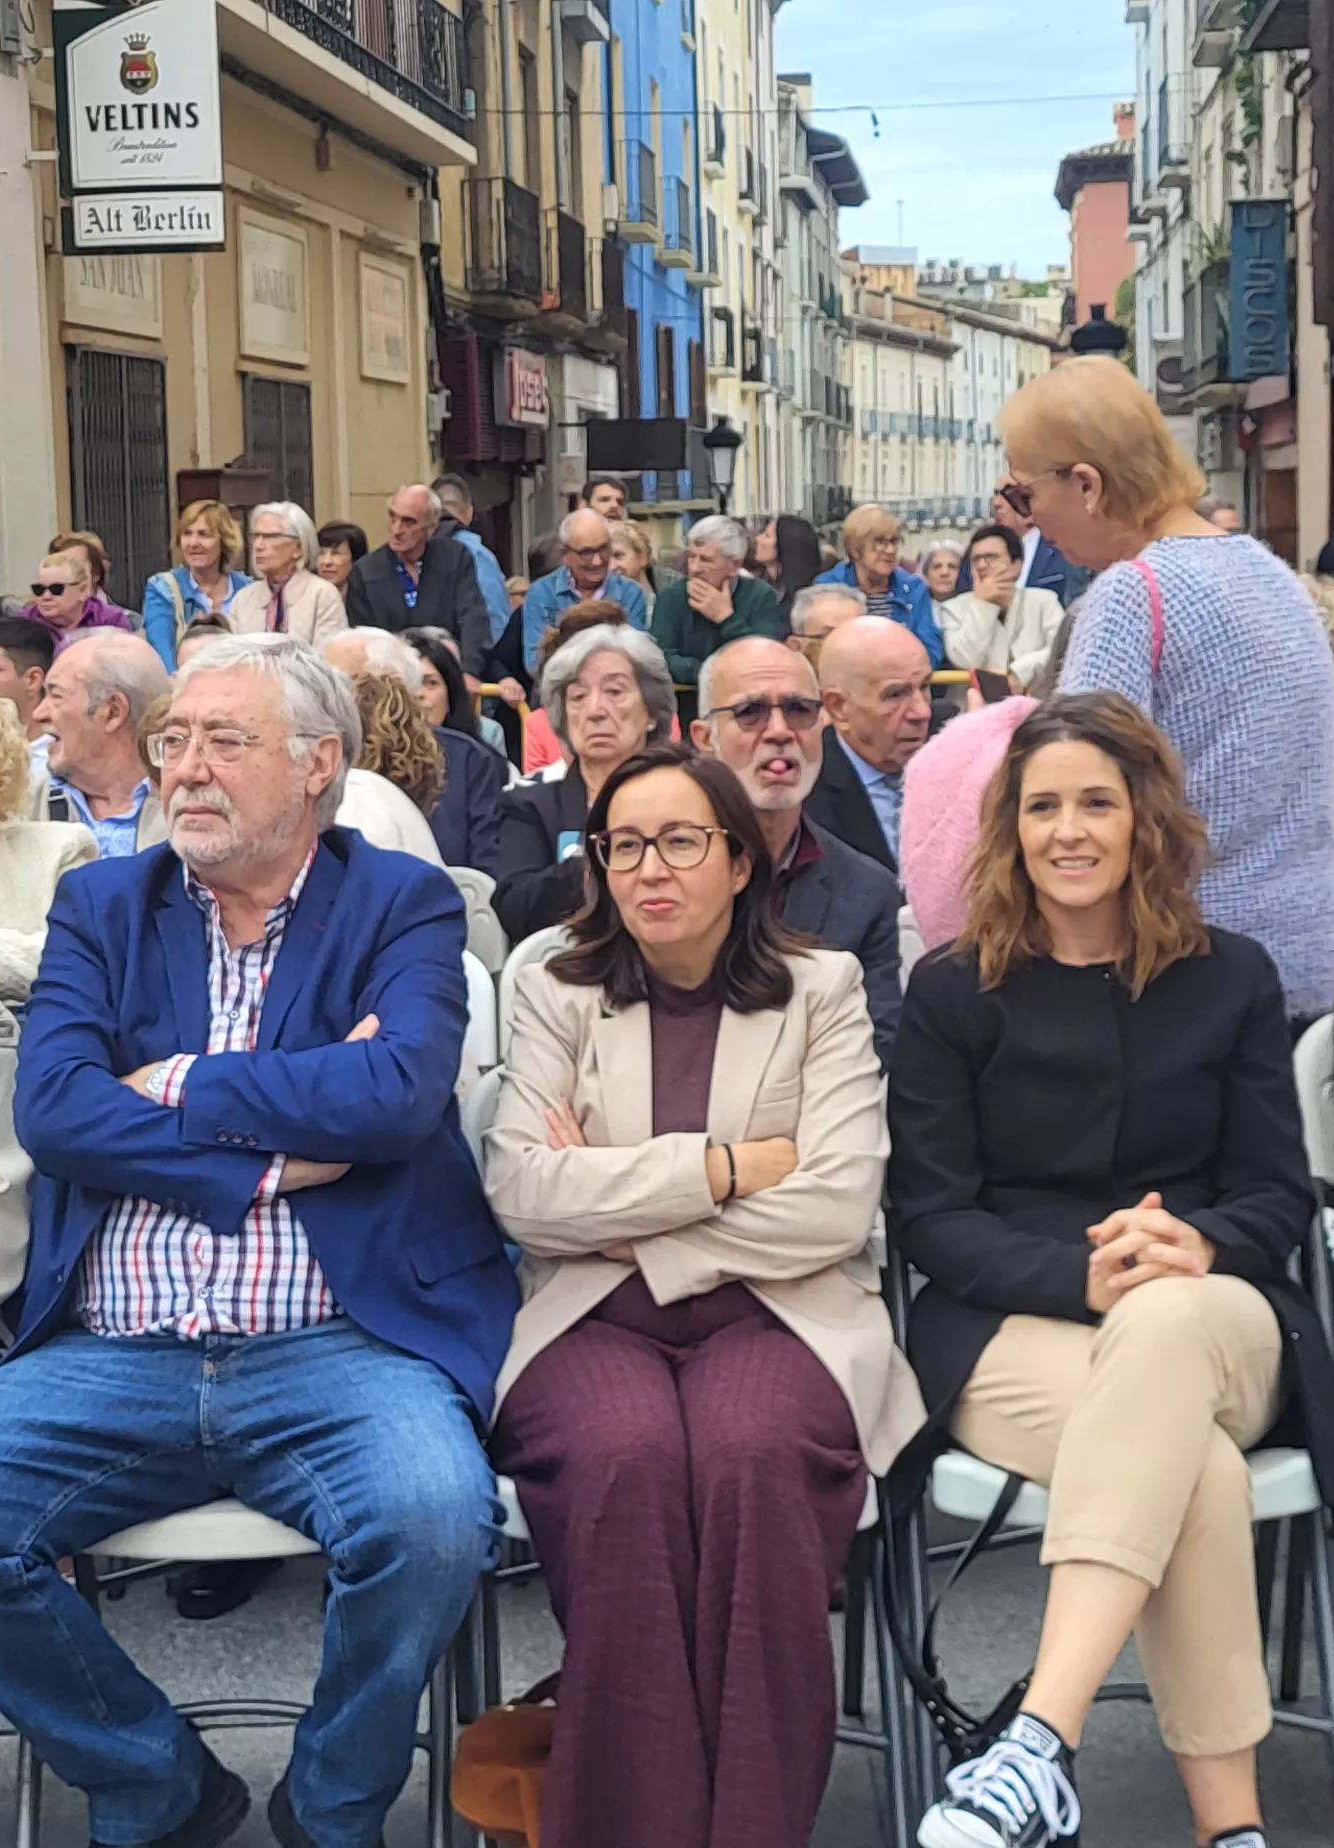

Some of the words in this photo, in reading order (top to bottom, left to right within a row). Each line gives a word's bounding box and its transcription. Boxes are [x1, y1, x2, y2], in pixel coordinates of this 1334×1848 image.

[85, 101, 200, 132] VELTINS
[84, 206, 123, 234] Alt
[1241, 202, 1278, 374] DISCOS
